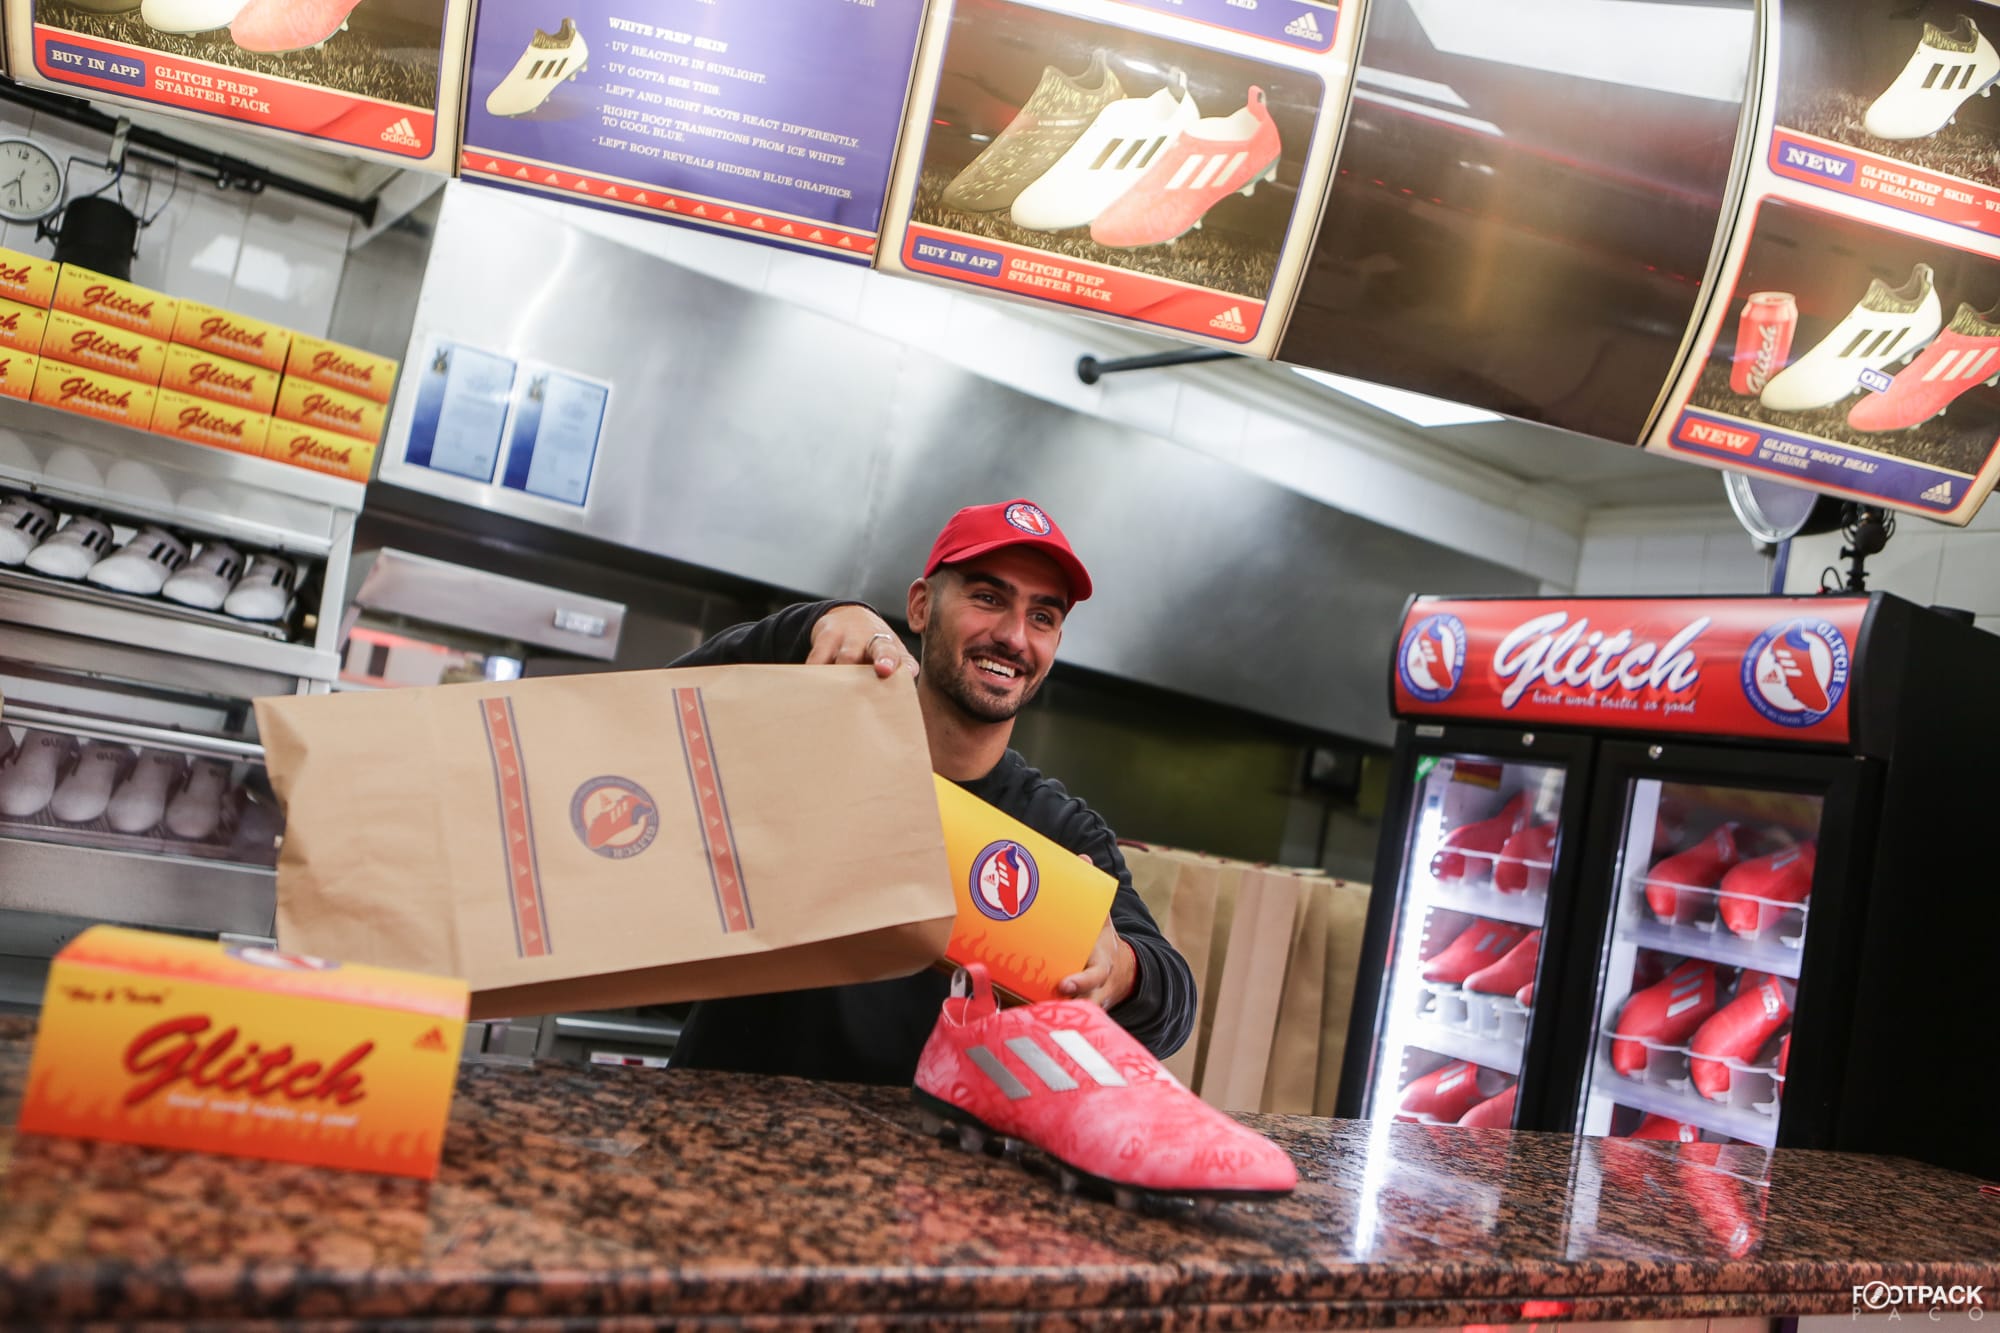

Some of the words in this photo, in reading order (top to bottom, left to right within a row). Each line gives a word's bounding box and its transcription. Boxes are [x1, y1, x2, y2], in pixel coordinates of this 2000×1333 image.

[609, 17, 653, 36] WHITE
[52, 50, 83, 65] BUY
[88, 58, 105, 71] IN
[110, 63, 140, 78] APP
[612, 41, 629, 53] UV
[631, 45, 688, 67] REACTIVE
[691, 58, 704, 70] IN
[707, 63, 767, 84] SUNLIGHT.
[155, 66, 212, 86] GLITCH
[217, 79, 258, 97] PREP
[609, 63, 625, 74] UV
[628, 67, 665, 84] GOTTA
[668, 76, 690, 89] SEE
[692, 81, 721, 96] THIS.
[155, 79, 226, 104] STARTER
[230, 95, 271, 114] PACK
[602, 116, 617, 127] TO
[619, 120, 650, 135] COOL
[653, 127, 685, 142] BLUE.
[606, 83, 635, 98] LEFT
[637, 91, 662, 104] AND
[665, 97, 701, 113] RIGHT
[703, 105, 740, 121] BOOTS
[742, 113, 780, 130] REACT
[782, 122, 859, 148] DIFFERENTLY.
[380, 132, 421, 148] adidas
[603, 105, 639, 120] RIGHT
[642, 113, 673, 127] BOOT
[675, 120, 750, 145] TRANSITIONS
[752, 137, 785, 152] FROM
[787, 145, 806, 157] ICE
[808, 150, 845, 166] WHITE
[599, 136, 627, 150] LEFT
[630, 143, 661, 158] BOOT
[662, 150, 714, 169] REVEALS
[716, 161, 760, 179] HIDDEN
[763, 172, 793, 186] BLUE
[794, 179, 853, 199] GRAPHICS.
[1786, 147, 1848, 177] NEW
[1860, 177, 1876, 191] UV
[1879, 184, 1936, 207] REACTIVE
[1862, 165, 1908, 187] GLITCH
[1909, 178, 1942, 195] PREP
[1943, 188, 1974, 205] SKIN
[918, 244, 947, 259] BUY
[950, 251, 967, 263] IN
[969, 256, 998, 270] APP
[1008, 270, 1071, 293] STARTER
[1075, 285, 1112, 302] PACK
[1010, 258, 1063, 278] GLITCH
[1066, 270, 1104, 287] PREP
[82, 285, 155, 319] Glitch
[200, 316, 267, 348] Glitch
[1209, 319, 1246, 334] adidas
[70, 330, 143, 363] Glitch
[189, 362, 256, 392] Glitch
[312, 351, 375, 381] Glitch
[1860, 370, 1890, 391] OR
[60, 377, 132, 408] Glitch
[178, 407, 245, 436] Glitch
[302, 394, 365, 423] Glitch
[289, 435, 353, 465] Glitch
[1689, 423, 1749, 449] NEW
[1763, 438, 1808, 458] GLITCH
[1493, 611, 1712, 711] Glitch
[1816, 623, 1848, 683] GLITCH
[122, 1014, 375, 1107] Glitch
